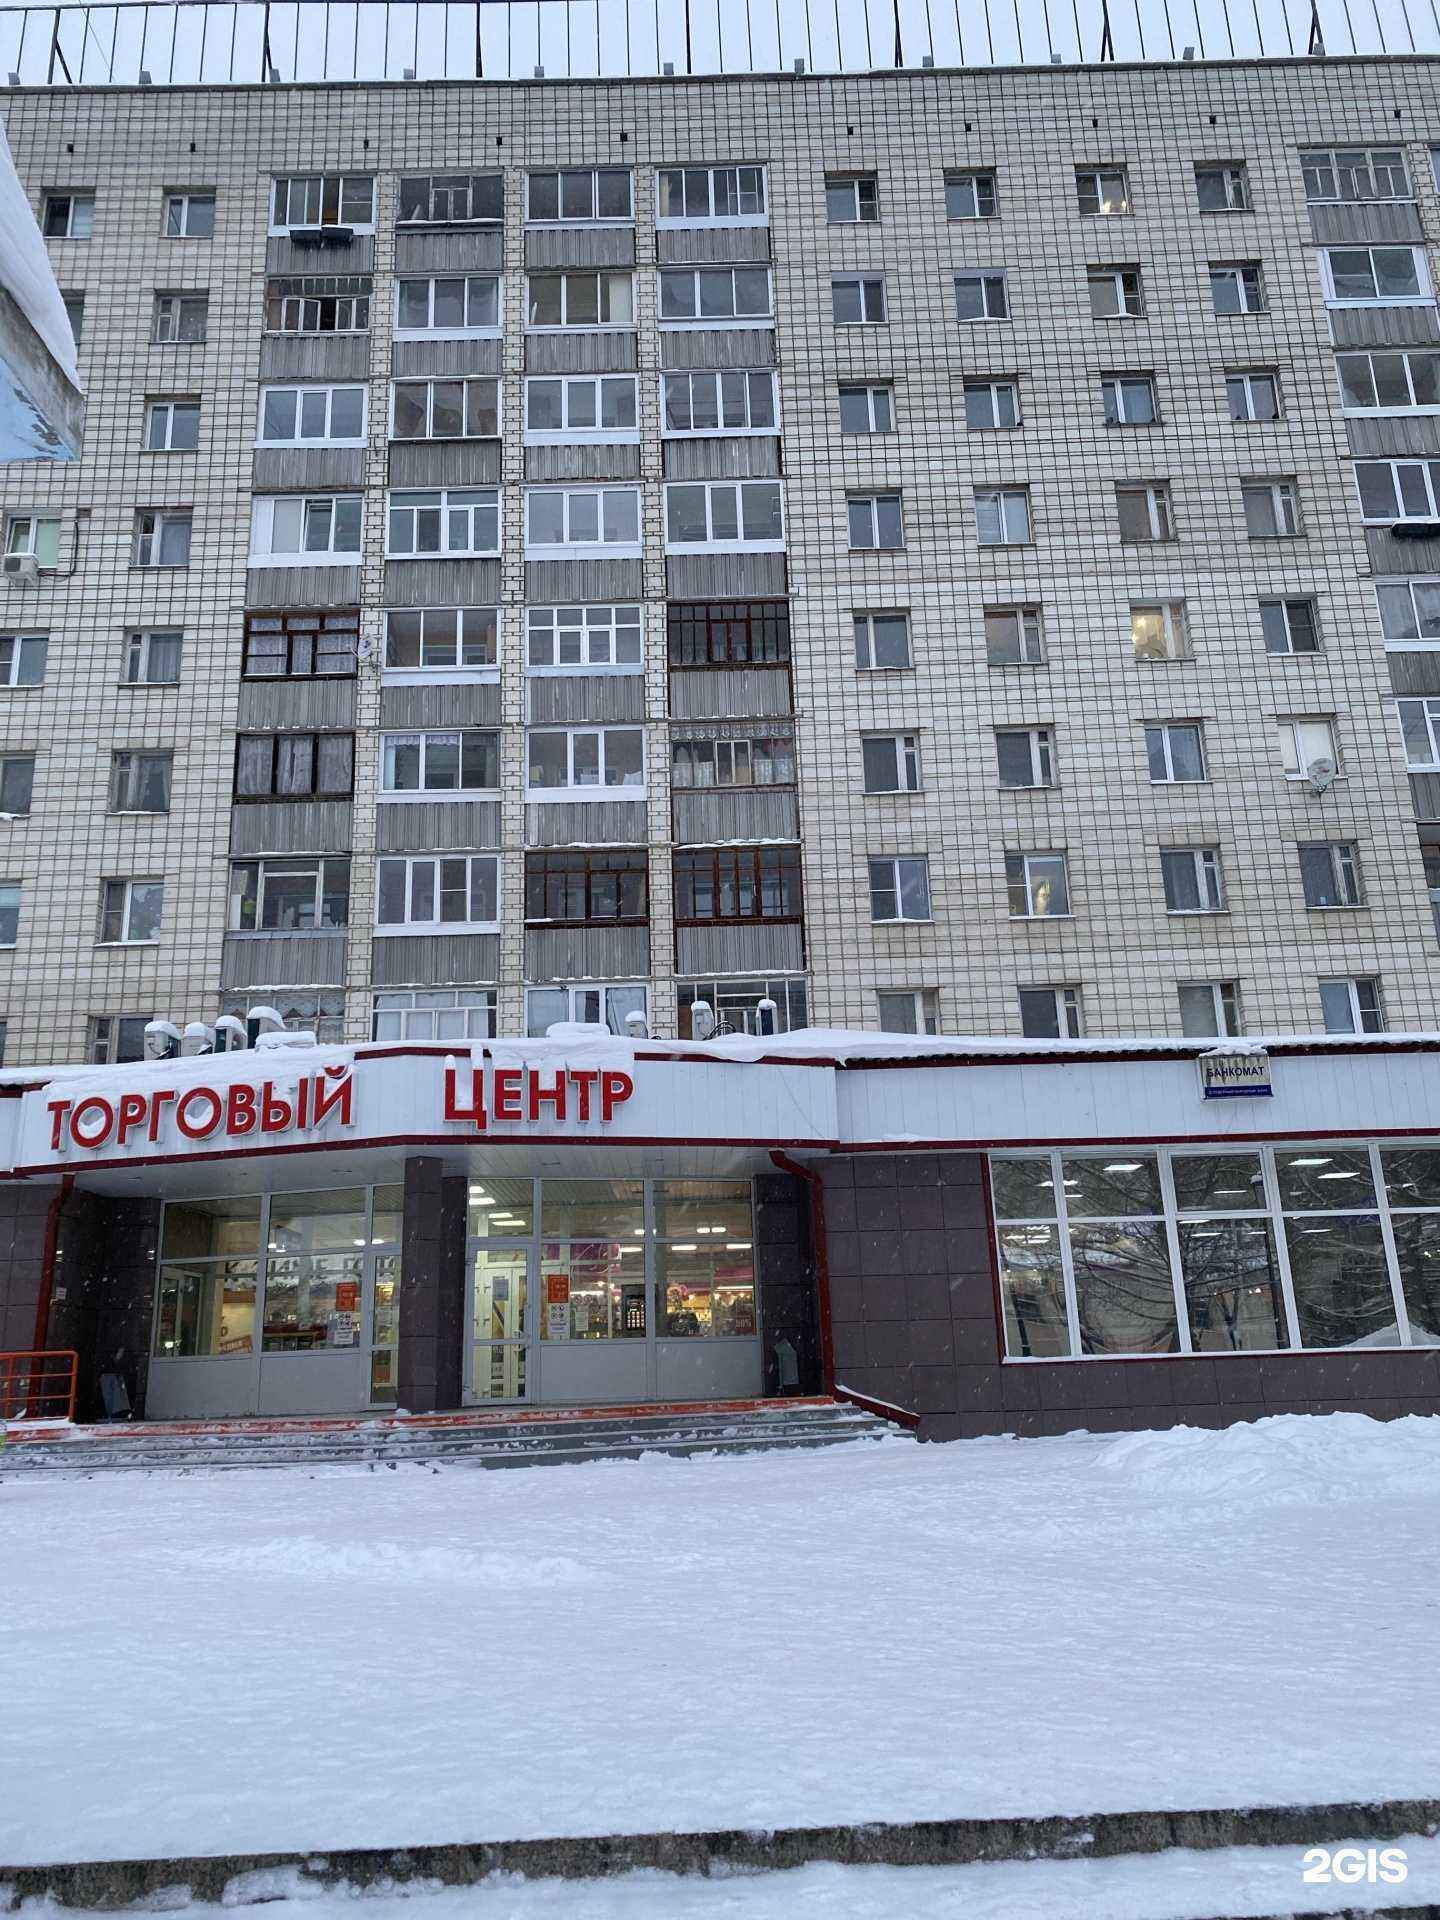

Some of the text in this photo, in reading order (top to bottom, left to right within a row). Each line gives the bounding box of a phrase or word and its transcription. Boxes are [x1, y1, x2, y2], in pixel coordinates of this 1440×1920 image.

[1206, 1066, 1264, 1078] БАНКОМАТ
[47, 1064, 634, 1150] ТОРГОВЫЙ ЦЕНТР
